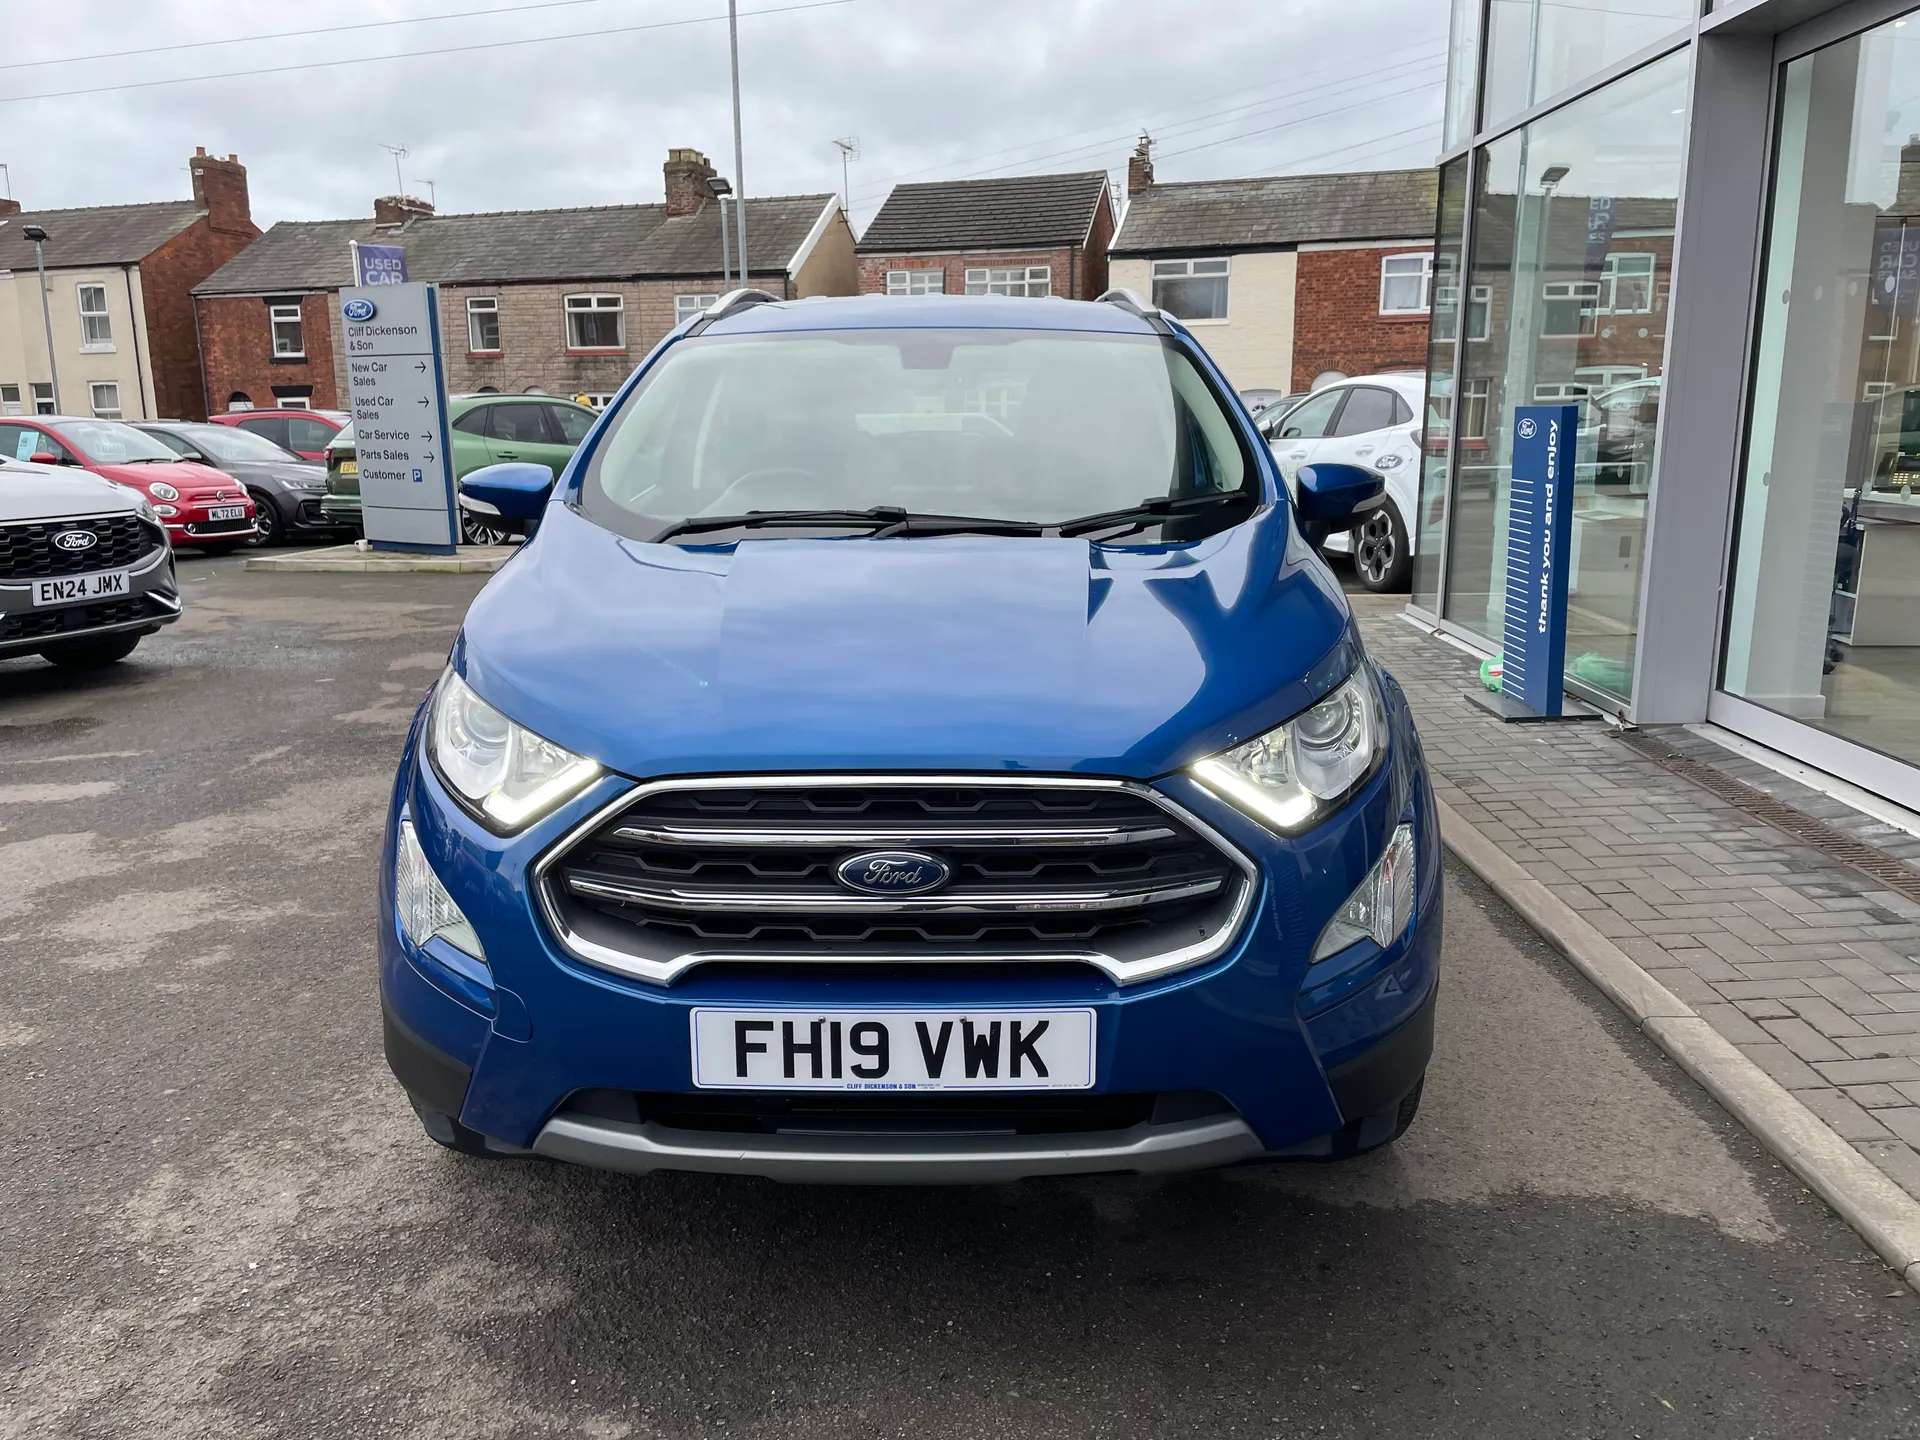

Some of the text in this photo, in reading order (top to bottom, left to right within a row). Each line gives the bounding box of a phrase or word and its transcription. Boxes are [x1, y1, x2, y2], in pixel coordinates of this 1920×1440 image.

[364, 257, 402, 270] USED
[365, 271, 403, 286] CAR
[348, 325, 418, 337] Cliff Dickenson
[349, 340, 374, 351] & Son
[351, 362, 388, 373] New Car
[353, 376, 376, 387] Sales
[355, 396, 394, 407] Used Car
[356, 409, 379, 420] Sales
[358, 429, 410, 441] Car Service
[360, 449, 410, 461] Parts Sales
[363, 468, 406, 481] Customer
[1539, 419, 1559, 634] thank you and enjoy
[64, 533, 90, 548] Ford
[41, 574, 122, 601] EN24 JMX
[863, 859, 923, 885] Ford
[735, 1019, 1050, 1079] FH19 VWK
